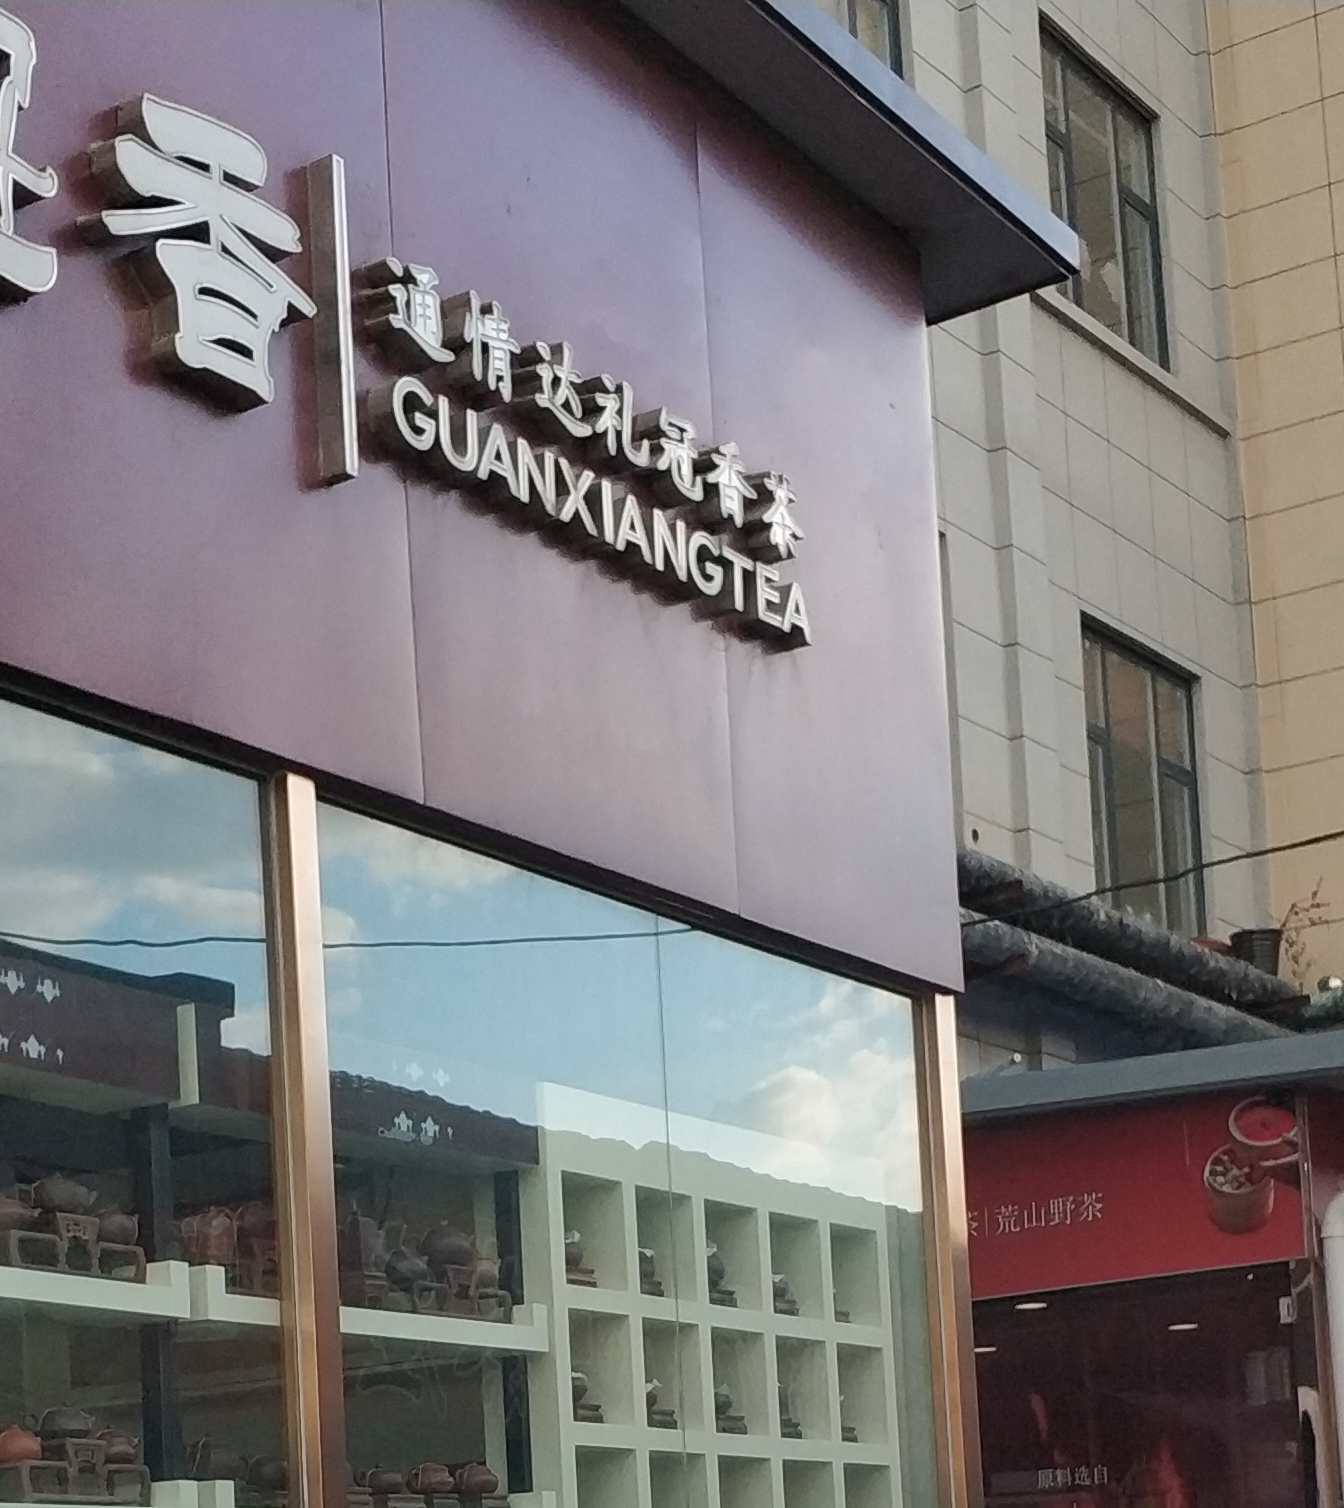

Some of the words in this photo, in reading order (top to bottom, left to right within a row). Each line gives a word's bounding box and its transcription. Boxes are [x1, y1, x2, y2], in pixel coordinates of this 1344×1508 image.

[388, 256, 805, 559] 通情达礼冠香茶
[392, 375, 813, 647] GUANXIANGTEA
[994, 1191, 1105, 1236] 荒山野茶
[1036, 1464, 1109, 1490] 原料选自
